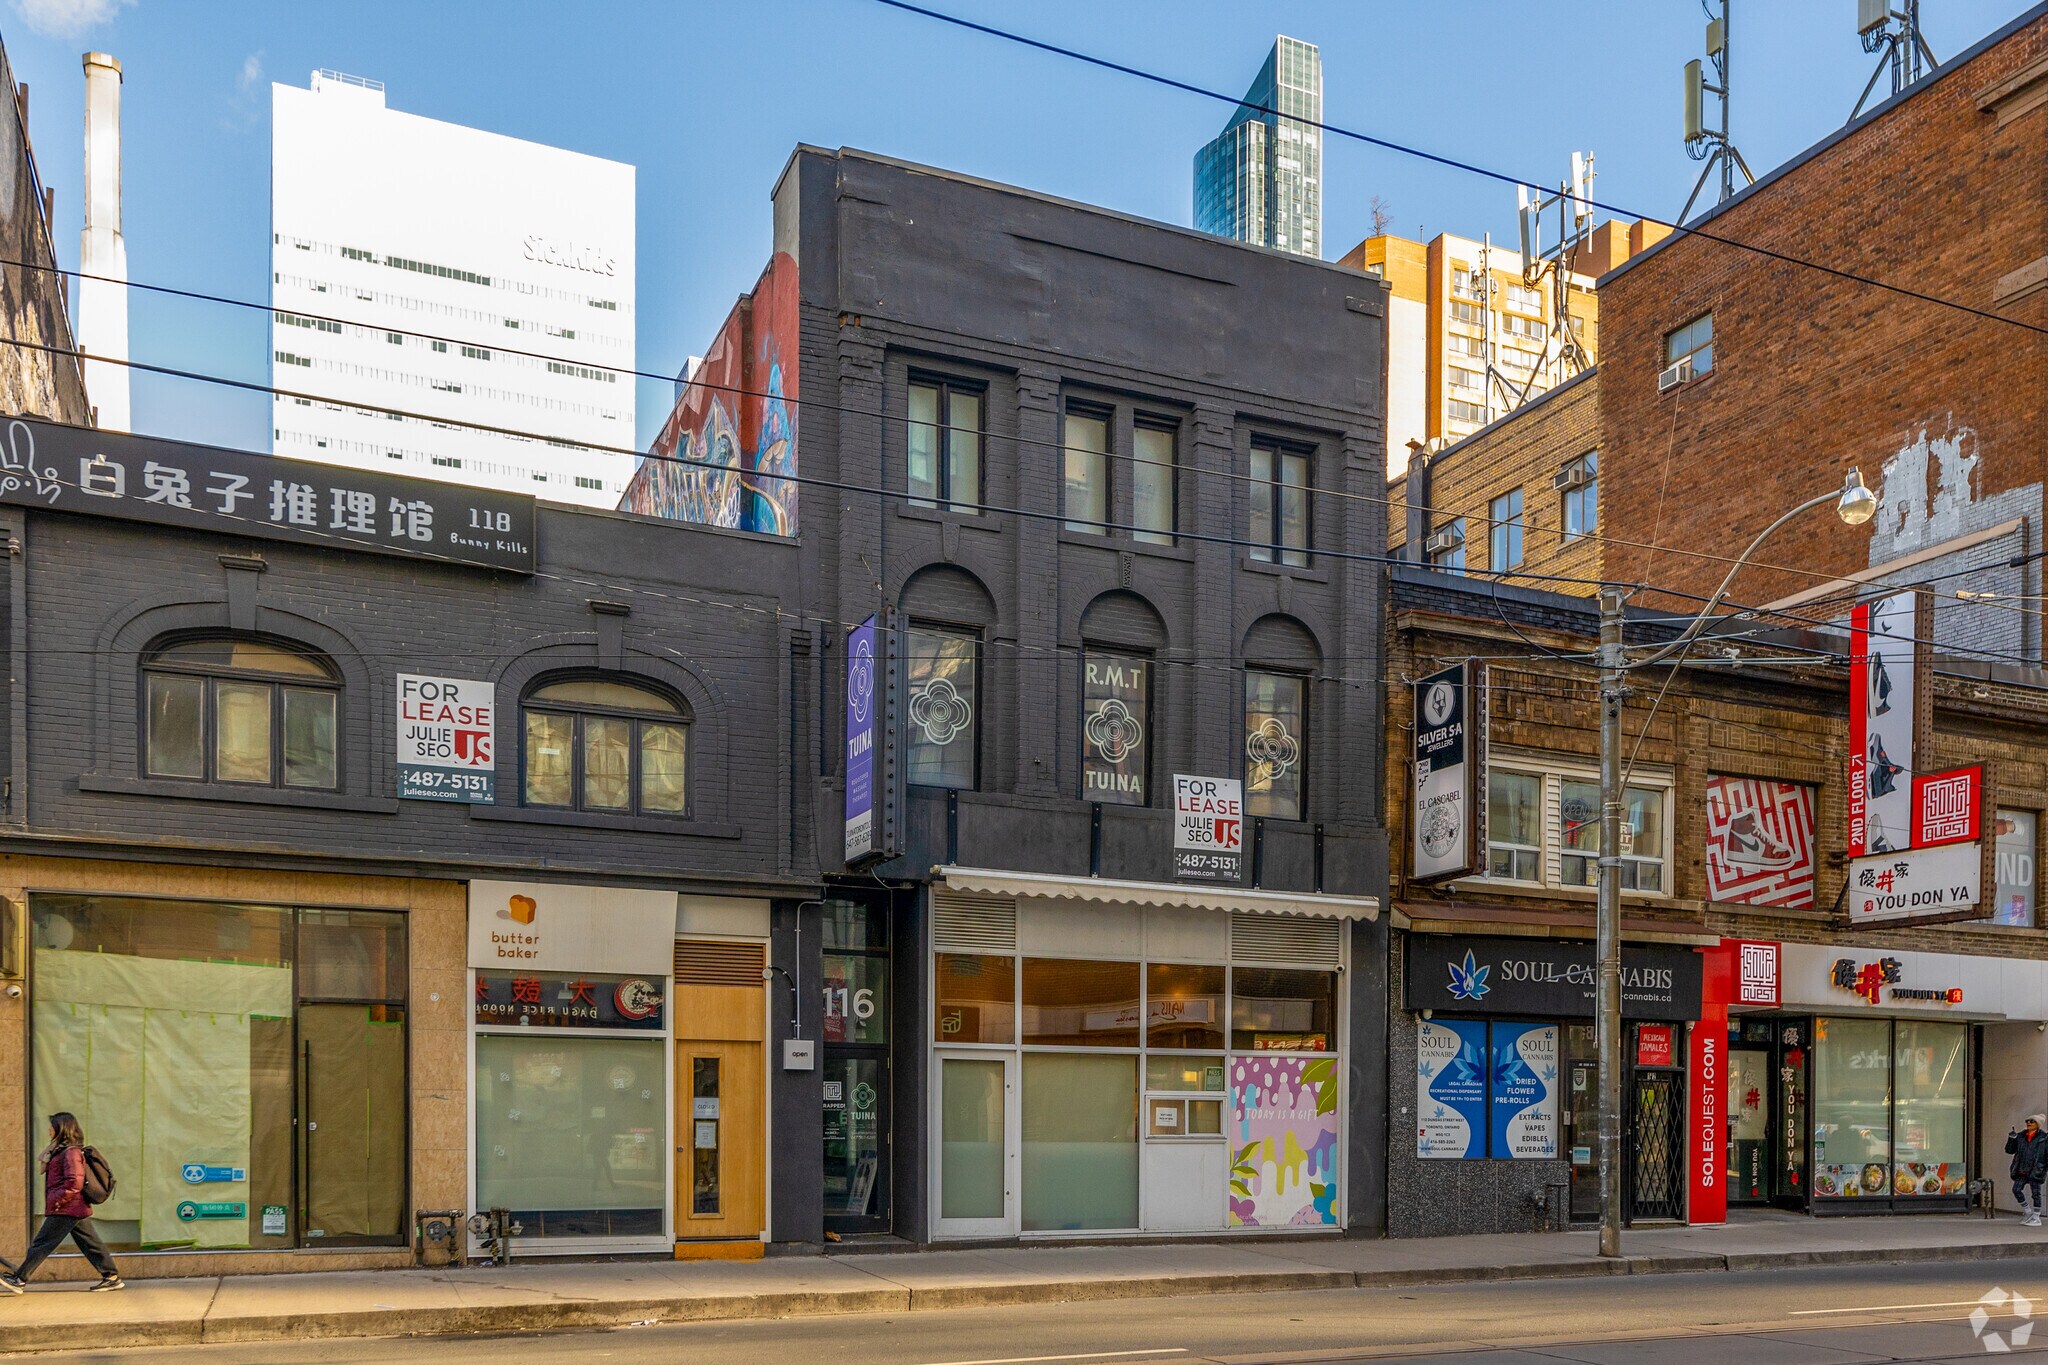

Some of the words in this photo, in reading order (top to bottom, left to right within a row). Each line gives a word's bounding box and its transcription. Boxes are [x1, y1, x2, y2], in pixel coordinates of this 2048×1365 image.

[79, 454, 434, 543] 白兔子推理馆
[469, 507, 511, 533] 118
[450, 532, 489, 551] Bunny
[496, 538, 528, 555] Kills
[403, 679, 459, 703] FOR
[403, 700, 490, 726] LEASE
[406, 725, 451, 742] JULIE
[1418, 727, 1448, 747] SILVER
[416, 742, 451, 758] SEO
[455, 731, 490, 766] JS
[849, 727, 872, 760] TUINA
[1427, 738, 1453, 753] JEWELLERS
[409, 771, 487, 791] 487-5131
[1086, 770, 1141, 793] TUINA
[1178, 779, 1217, 797] FOR
[404, 787, 458, 798] julieseo.com
[1419, 799, 1426, 811] EL
[1427, 790, 1461, 808] CASCABEL
[1852, 770, 1865, 815] FLOOR
[1179, 796, 1240, 816] LEASE
[1563, 803, 1587, 816] OPEN
[1181, 816, 1212, 830] JULIE
[1852, 817, 1864, 846] 2ND
[1188, 829, 1213, 843] SEO
[1215, 819, 1240, 849] JS
[1182, 854, 1236, 870] 487-5131
[1178, 868, 1216, 878] julieseo.com
[1876, 893, 1906, 911] YOU
[1912, 889, 1943, 906] DON
[1950, 886, 1969, 901] YA
[491, 931, 540, 945] butter
[497, 946, 539, 959] baker
[1501, 960, 1559, 983] SOUL
[822, 987, 875, 1018] 116
[1892, 988, 1913, 1000] YOU
[1914, 988, 1933, 1001] DON
[1934, 990, 1948, 1001] YA
[1421, 1036, 1455, 1049] SOUL
[1522, 1039, 1554, 1052] SOUL
[1643, 1033, 1666, 1042] MEXICAN
[1421, 1050, 1455, 1058] CANNABIS
[1640, 1042, 1668, 1053] TAMALES
[1522, 1053, 1554, 1061] CANNABIS
[1507, 1087, 1535, 1095] FLOWER
[1787, 1084, 1795, 1115] YOU
[851, 1111, 876, 1120] TUINA
[1245, 1107, 1275, 1120] TODAY
[1278, 1109, 1287, 1120] IS
[1289, 1109, 1296, 1120] A
[1297, 1109, 1319, 1121] GIFT
[1702, 1037, 1715, 1188] SOLEQUEST.COM
[1787, 1118, 1795, 1148] DON
[1787, 1151, 1795, 1171] YA
[1752, 1177, 1758, 1187] YA
[265, 1207, 284, 1215] PASS
